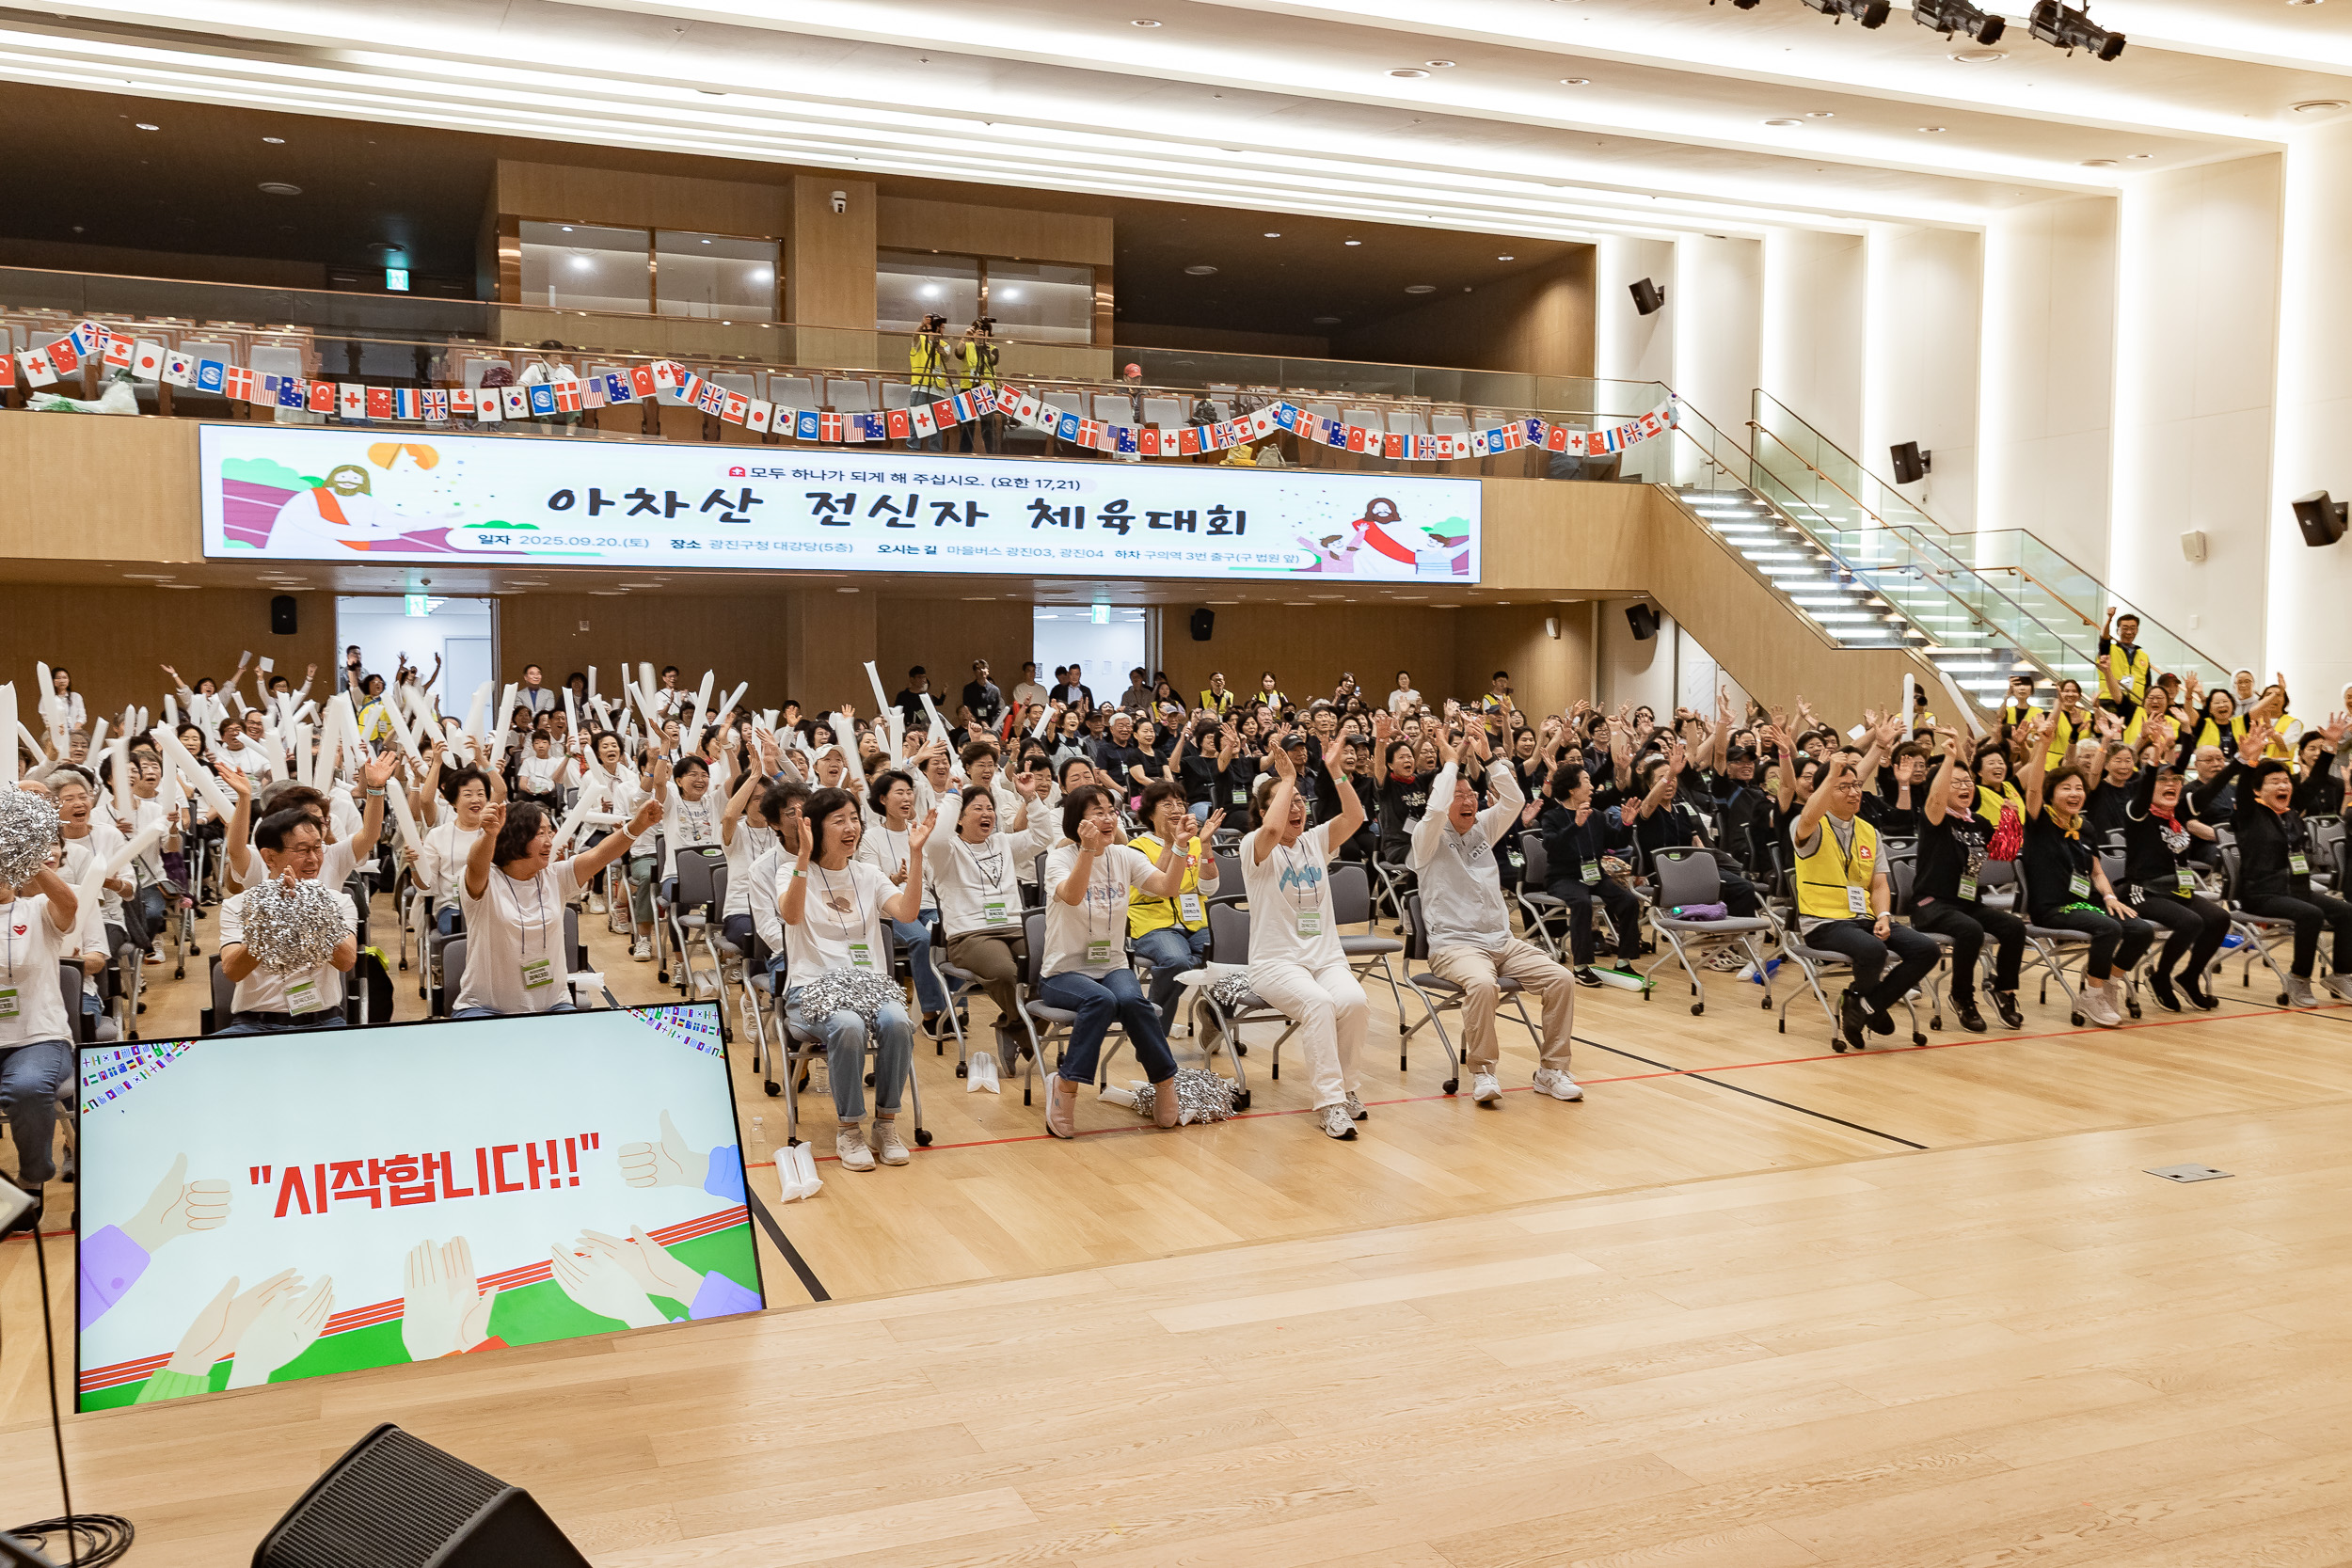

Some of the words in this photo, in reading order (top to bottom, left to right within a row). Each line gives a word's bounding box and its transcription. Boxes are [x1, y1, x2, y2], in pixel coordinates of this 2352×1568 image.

[750, 467, 787, 480] 모두
[791, 468, 845, 483] 하나가
[850, 470, 885, 483] 되게
[890, 471, 907, 484] 해
[913, 472, 985, 486] 주십시오.
[991, 475, 1030, 490] (요한
[1034, 477, 1081, 491] 17,21)
[548, 487, 764, 524] 아차산
[805, 492, 990, 529] 전신자
[1026, 498, 1247, 536] 체육대회
[478, 534, 511, 546] 일자
[519, 535, 650, 549] 2025.09.20.(토)
[670, 538, 702, 550] 장소
[708, 539, 769, 551] 광진구청
[773, 541, 853, 554] 대강당(5층)
[877, 544, 921, 555] 오시는
[924, 544, 938, 556] 길
[946, 545, 1003, 557] 마을버스
[1006, 546, 1056, 560] 광진03,
[1059, 547, 1104, 559] 광진04
[1114, 548, 1142, 561] 하차
[1144, 550, 1183, 562] 구의역
[1185, 550, 1207, 562] 3번
[1210, 551, 1253, 564] 출구(구
[1256, 553, 1280, 563] 법원
[1282, 553, 1300, 564] 앞)
[249, 1132, 601, 1219] "시작합니다!!"
